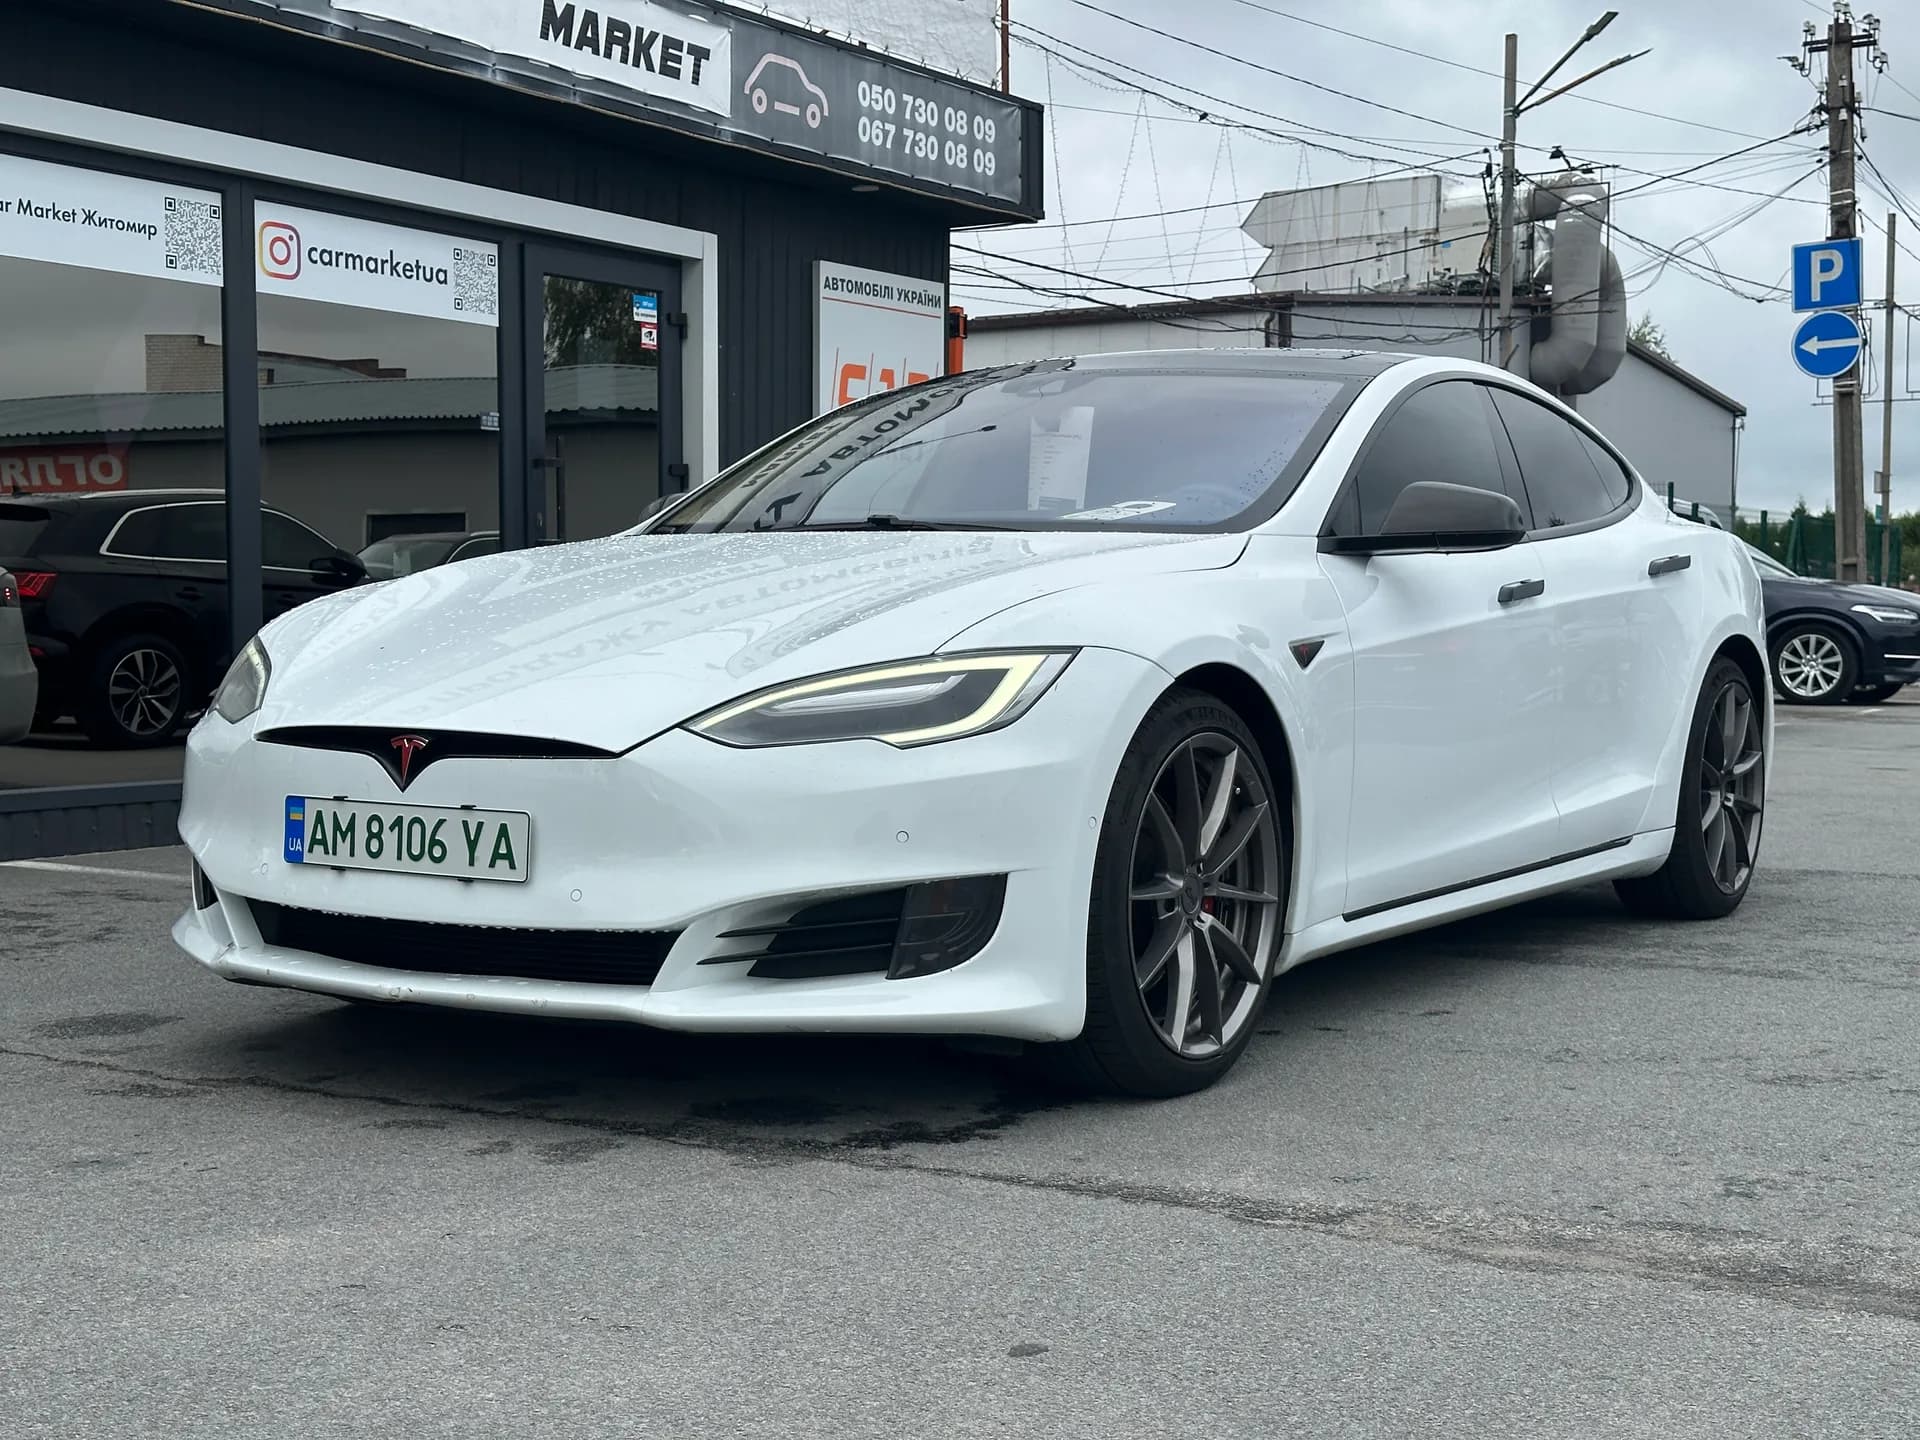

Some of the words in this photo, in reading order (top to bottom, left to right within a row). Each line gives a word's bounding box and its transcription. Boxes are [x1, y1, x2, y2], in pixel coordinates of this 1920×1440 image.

[539, 0, 711, 86] MARKET
[857, 81, 896, 115] 050
[902, 93, 938, 127] 730
[944, 107, 968, 136] 08
[973, 115, 996, 144] 09
[858, 116, 896, 149] 067
[903, 128, 939, 161] 730
[944, 140, 968, 169] 08
[973, 148, 996, 176] 09
[17, 198, 77, 224] Market
[81, 208, 158, 240] Житомир
[307, 246, 449, 285] carmarketua
[823, 275, 894, 301] АВТОМОБІЛІ
[896, 287, 941, 309] УКРАЇНИ
[1811, 249, 1844, 302] P
[288, 837, 303, 852] UA
[307, 810, 356, 858] AM
[365, 814, 447, 864] 8106
[461, 820, 517, 870] YA
